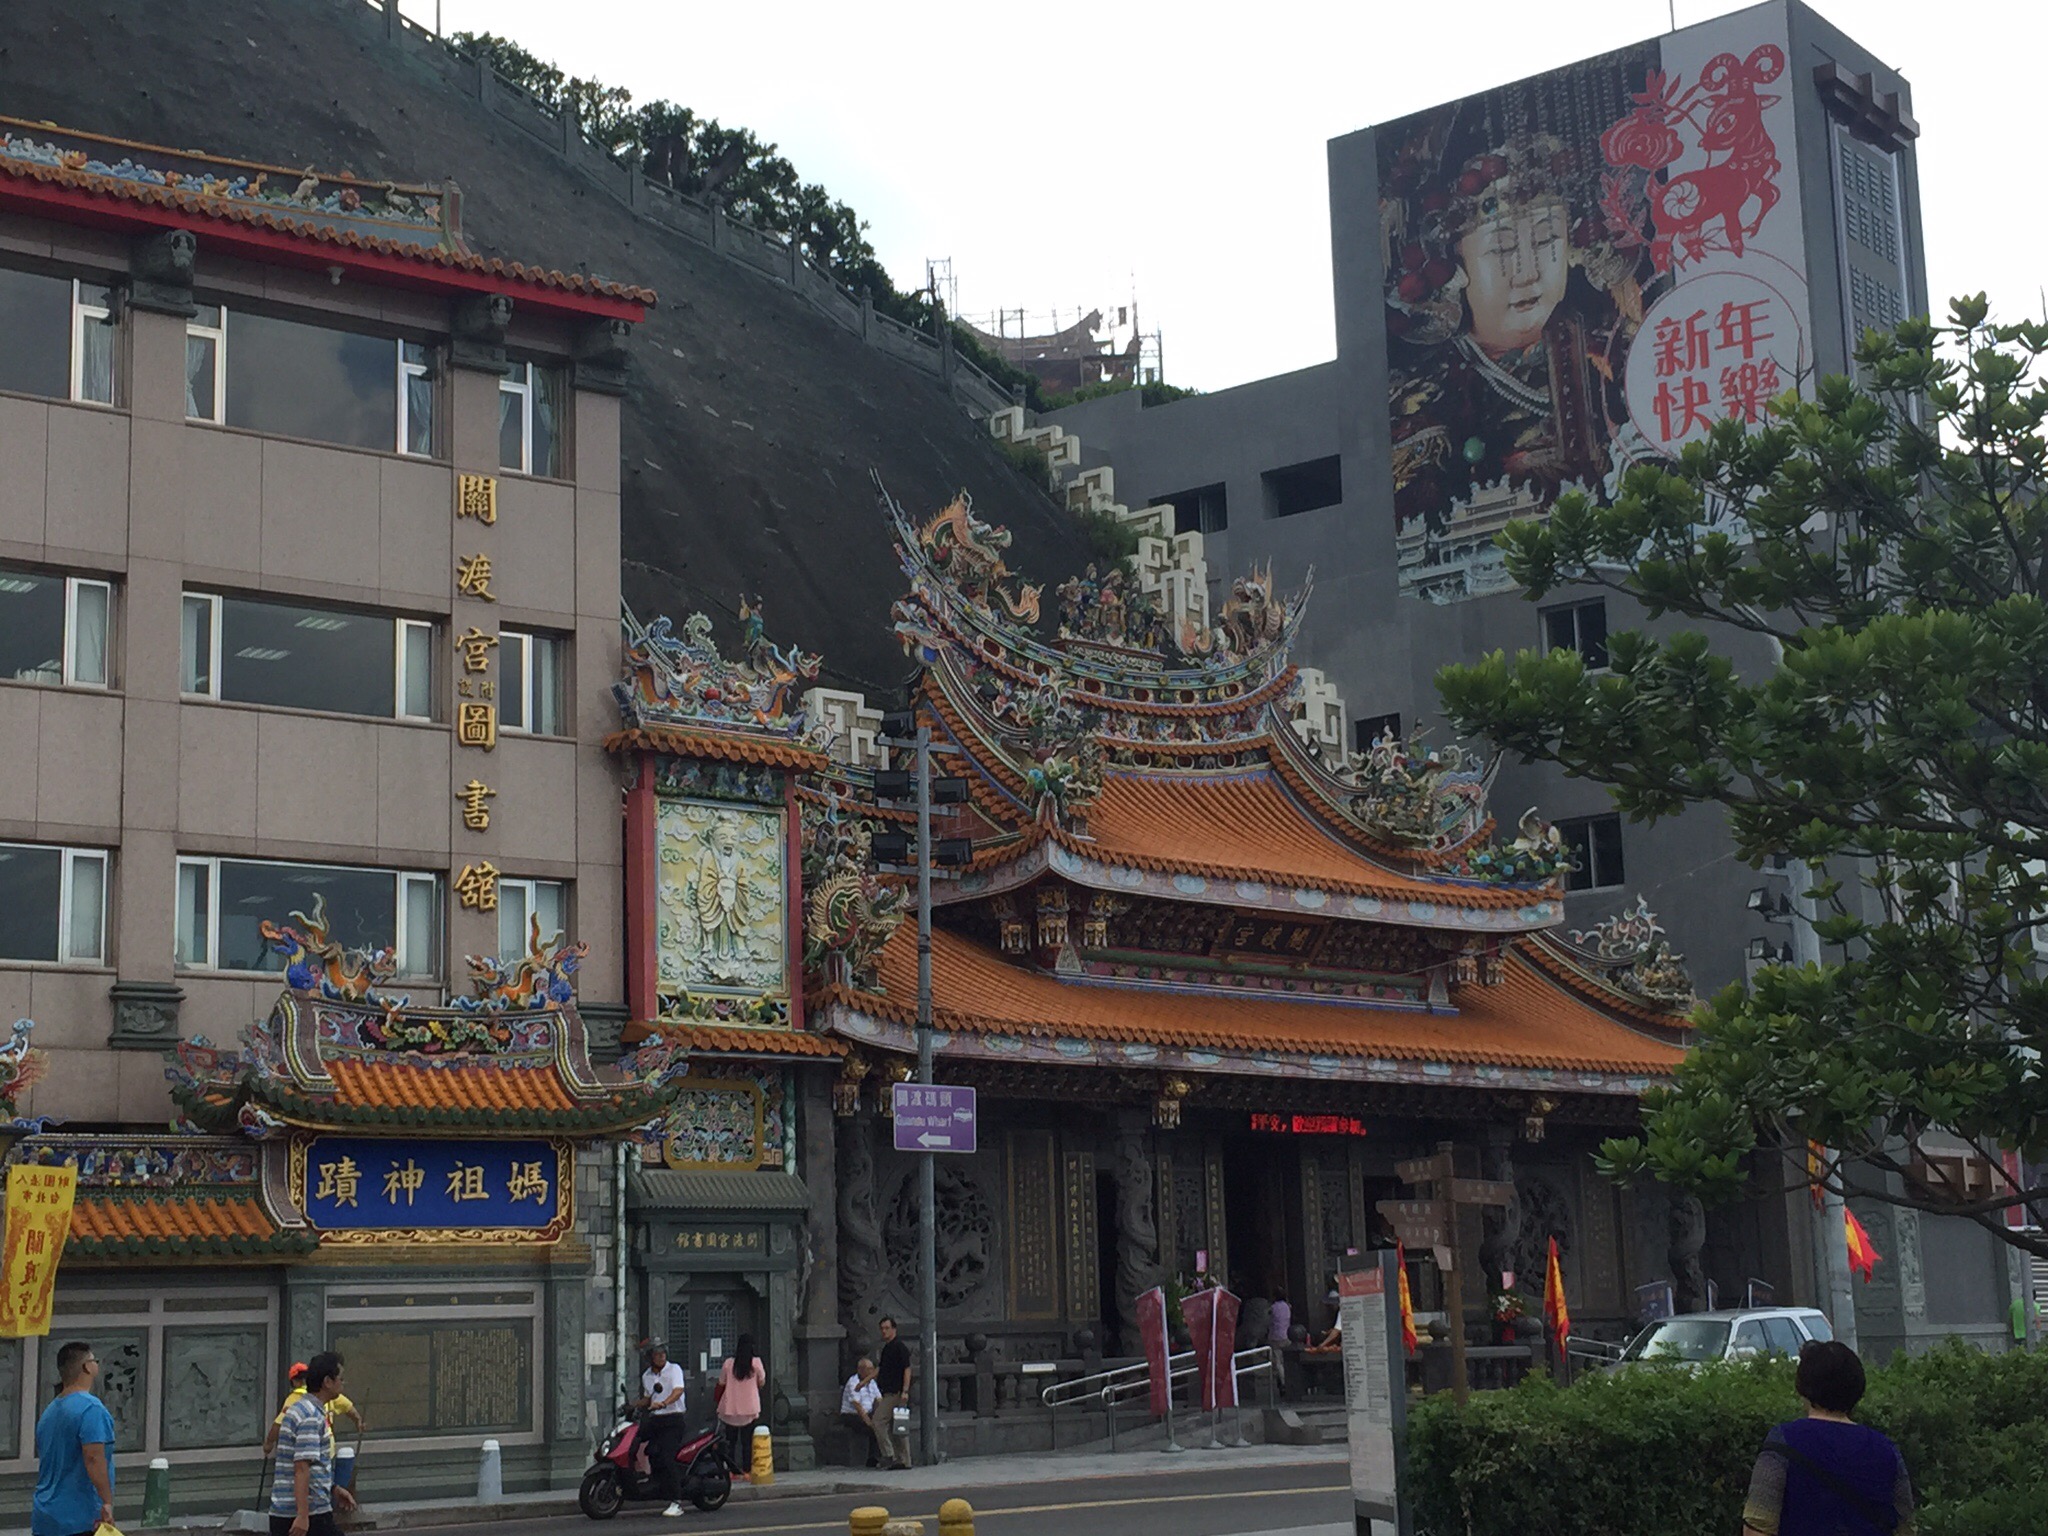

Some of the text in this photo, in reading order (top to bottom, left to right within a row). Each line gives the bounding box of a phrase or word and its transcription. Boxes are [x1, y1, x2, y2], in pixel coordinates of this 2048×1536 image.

[1652, 298, 1774, 378] 新年
[1653, 358, 1780, 442] 快樂
[927, 1115, 952, 1127] Wharf
[315, 1155, 549, 1208] 媽祖神蹟
